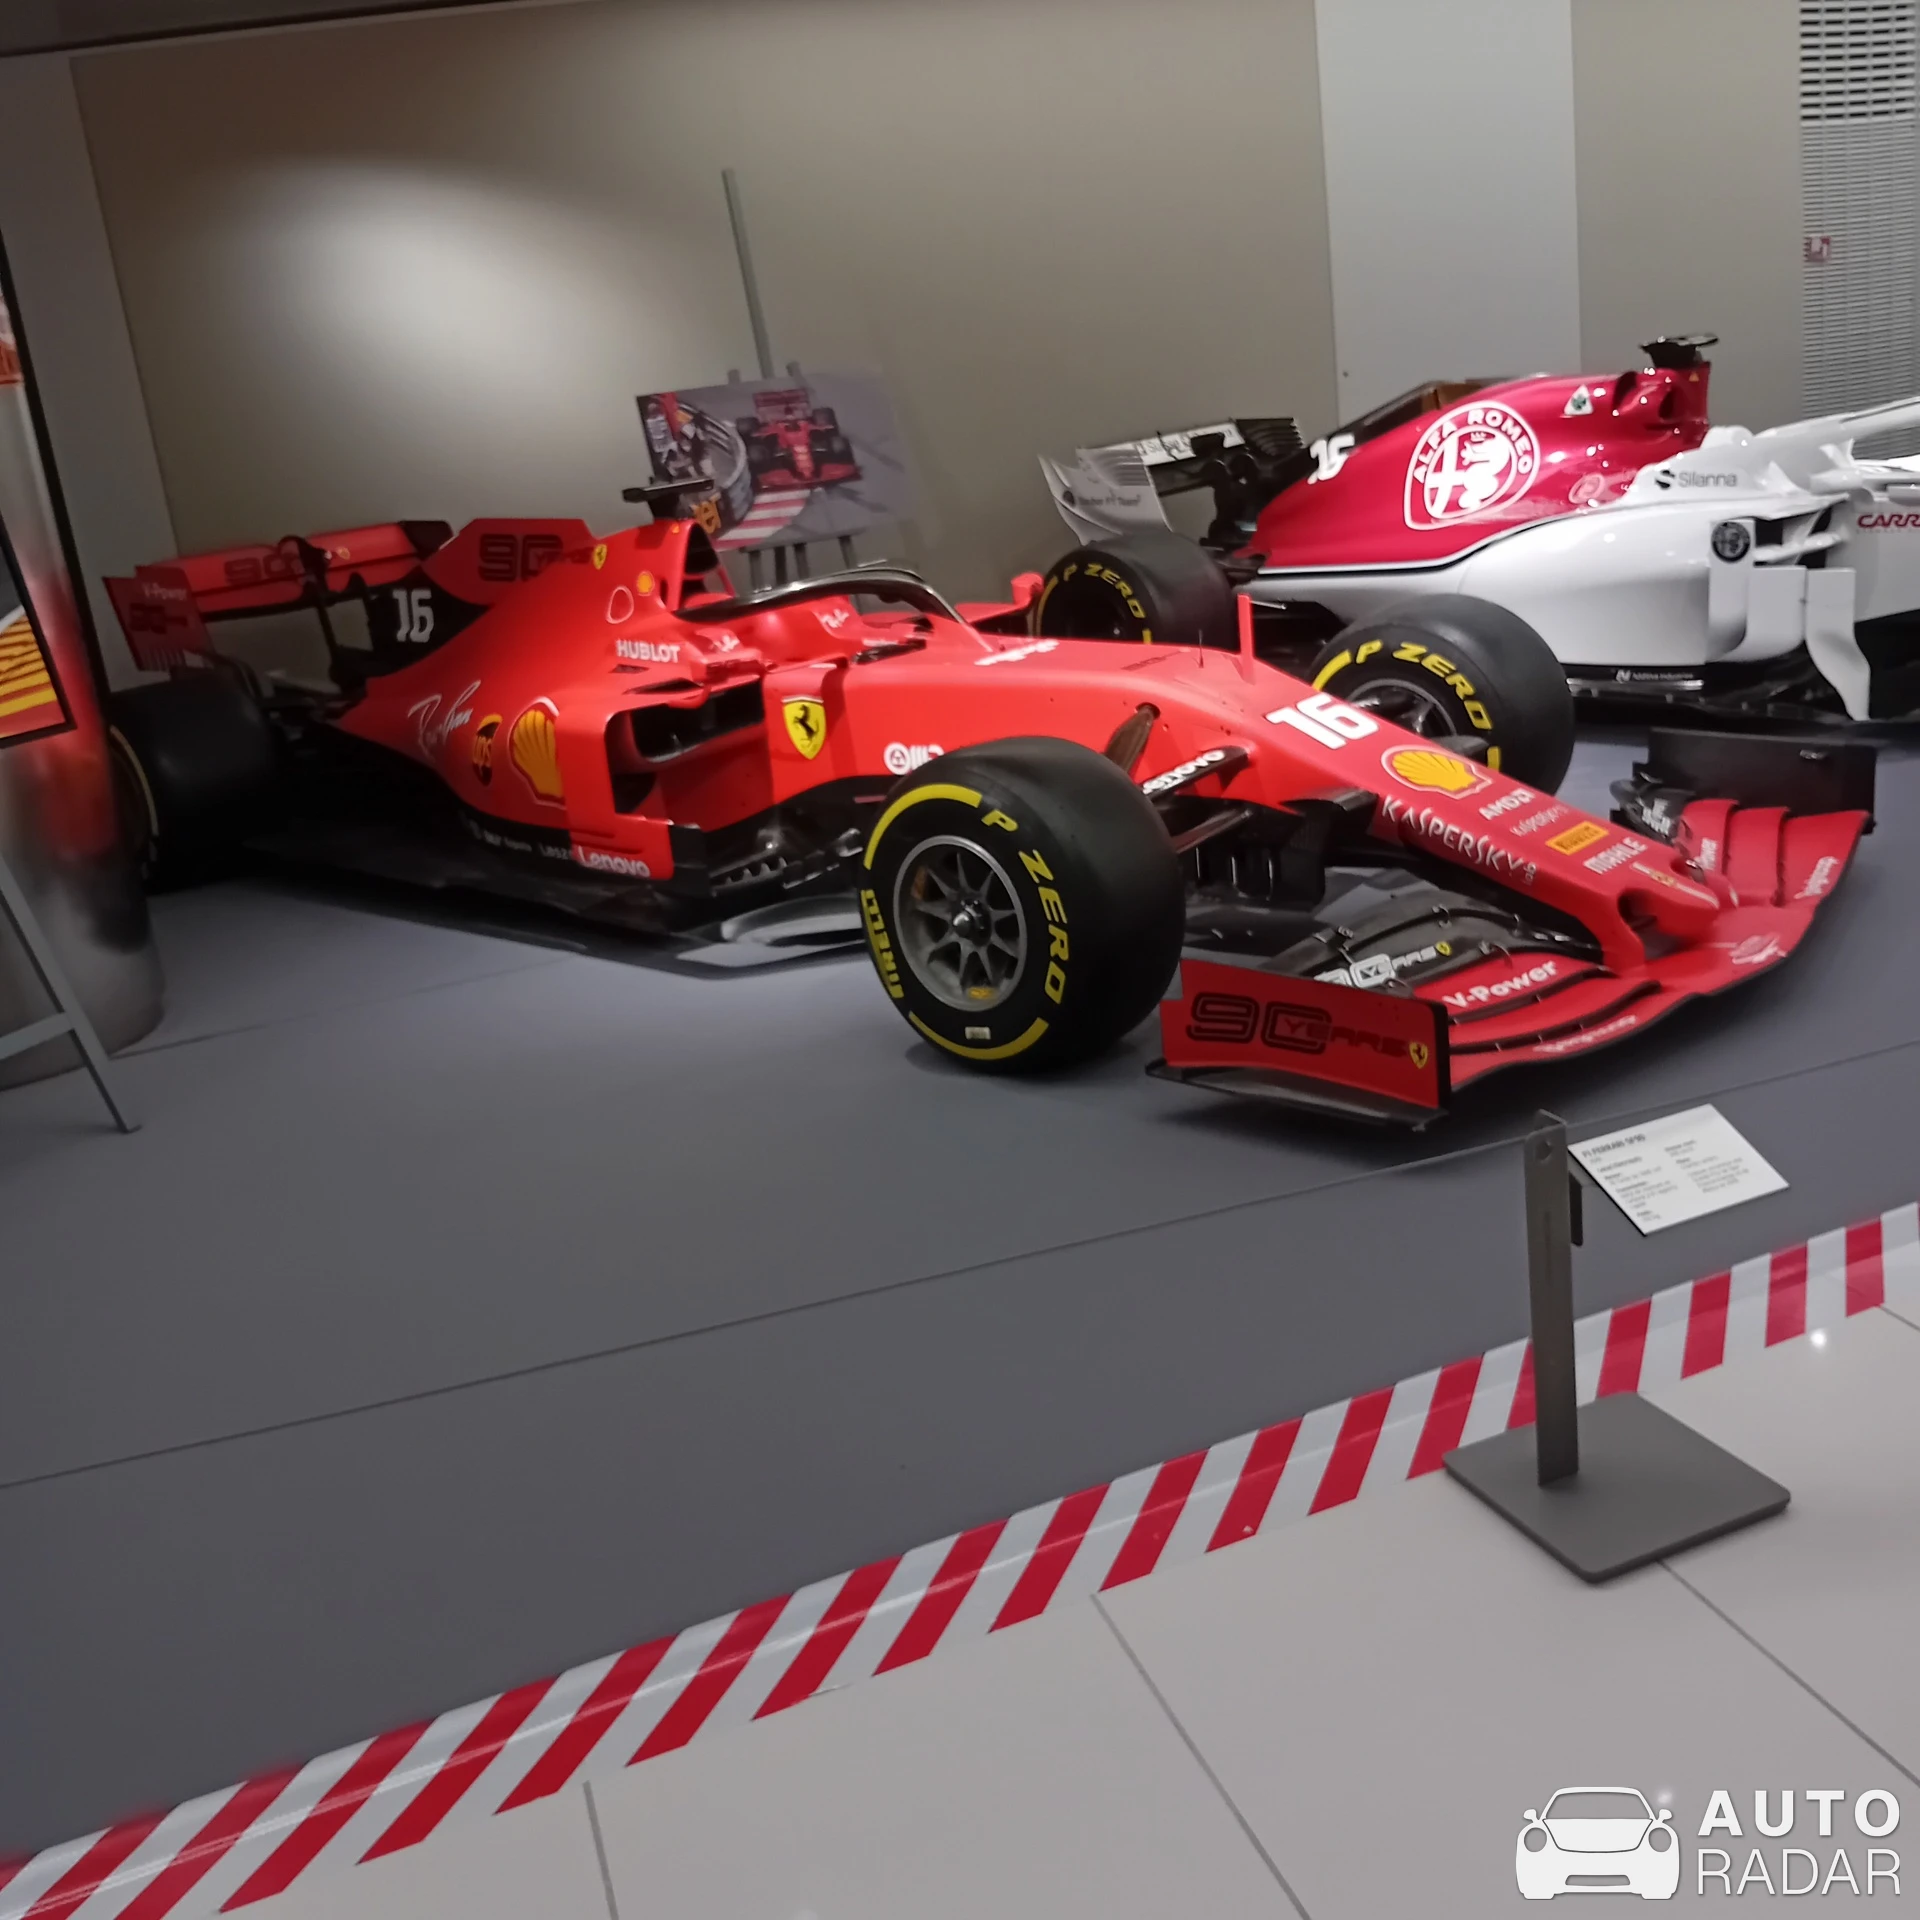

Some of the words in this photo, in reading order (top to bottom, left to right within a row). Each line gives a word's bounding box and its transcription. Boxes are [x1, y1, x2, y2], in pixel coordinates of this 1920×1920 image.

[1413, 421, 1458, 484] ALFA
[1467, 409, 1533, 475] ROMEO
[1679, 470, 1737, 488] Silanna
[393, 589, 434, 642] 16
[1084, 563, 1146, 619] ZERO
[616, 639, 680, 663] HUBLOT
[1356, 640, 1382, 664] P
[1392, 642, 1493, 731] ZERO
[1265, 692, 1380, 751] 16
[578, 845, 651, 878] Lenovo
[1381, 795, 1523, 877] KASPERSKY
[1583, 837, 1647, 875] MAHLE
[981, 809, 1018, 832] P
[1018, 849, 1070, 1005] ZERO
[1442, 960, 1558, 1009] V-Power
[1185, 992, 1333, 1056] 90
